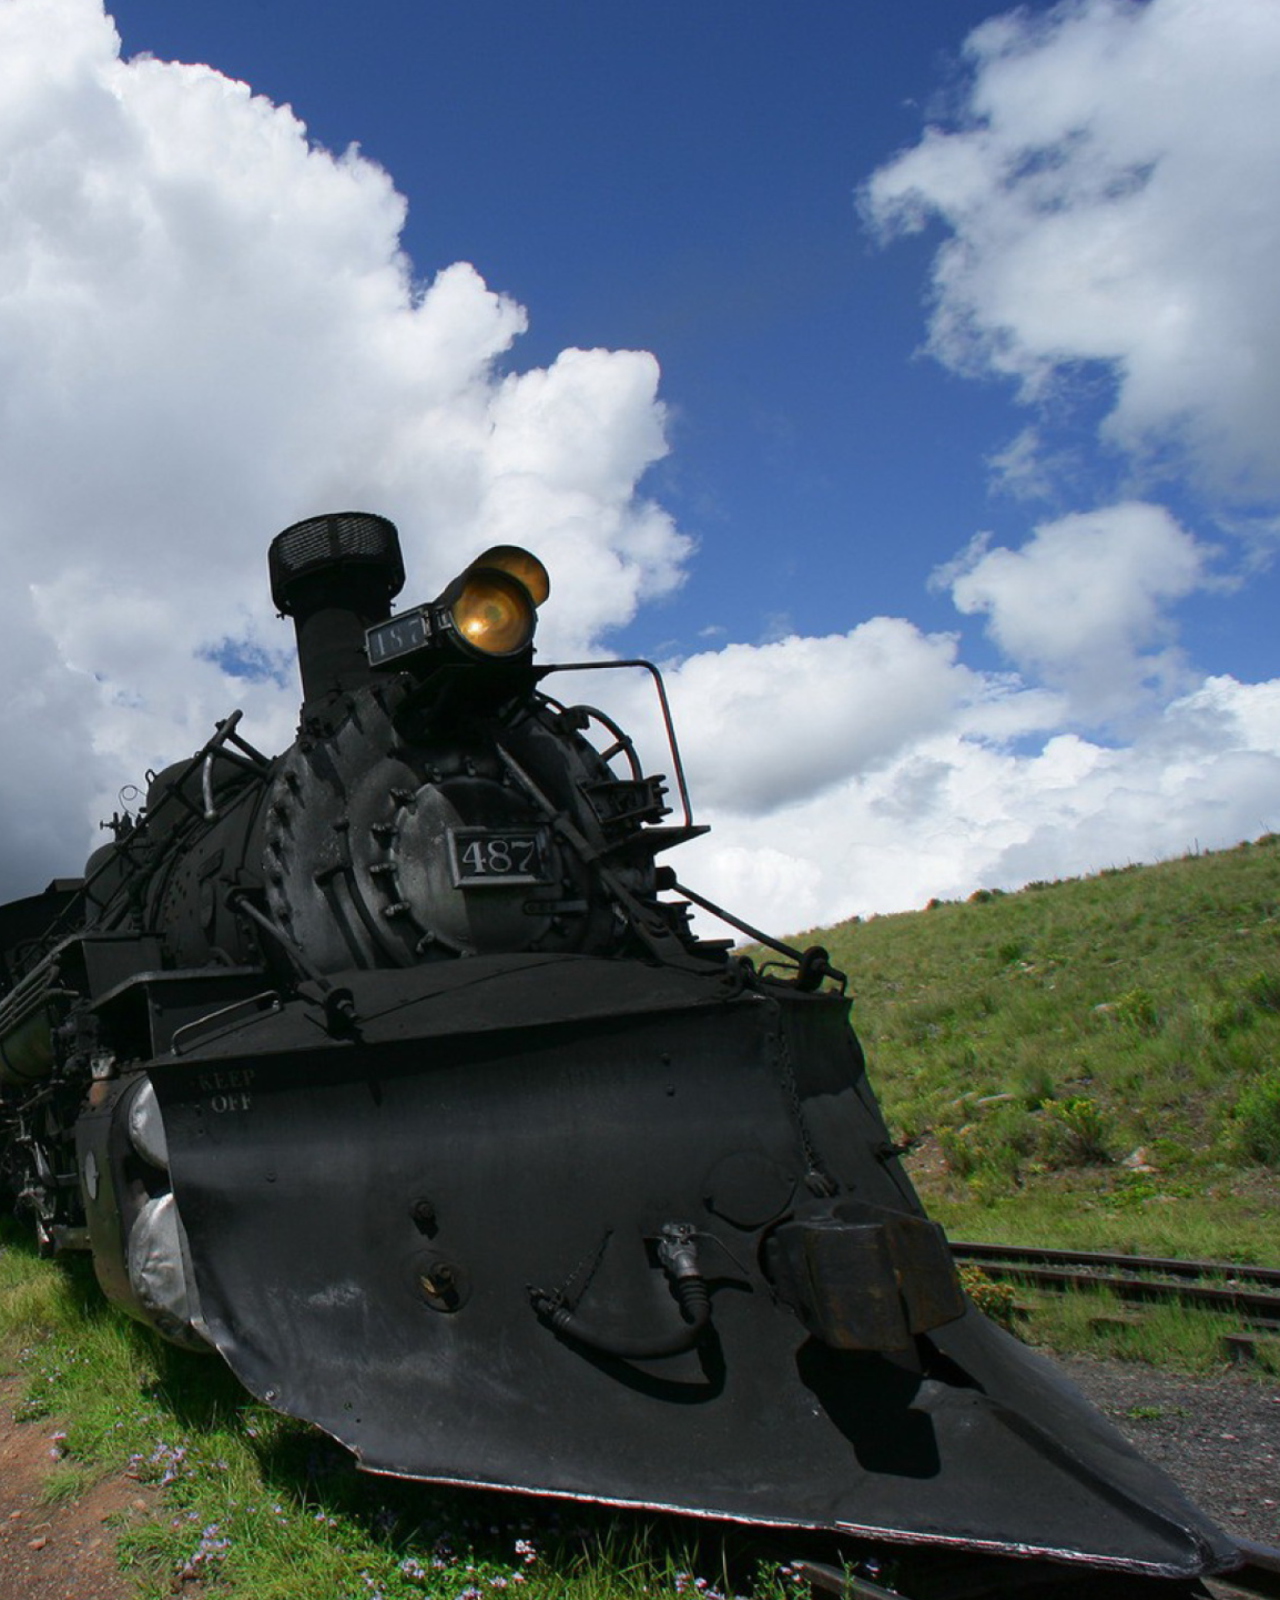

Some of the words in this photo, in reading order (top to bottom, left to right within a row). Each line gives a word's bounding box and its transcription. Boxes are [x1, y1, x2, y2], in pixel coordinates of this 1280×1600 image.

[462, 839, 535, 873] 487
[198, 1068, 256, 1091] KEEP
[211, 1092, 252, 1113] OFF
